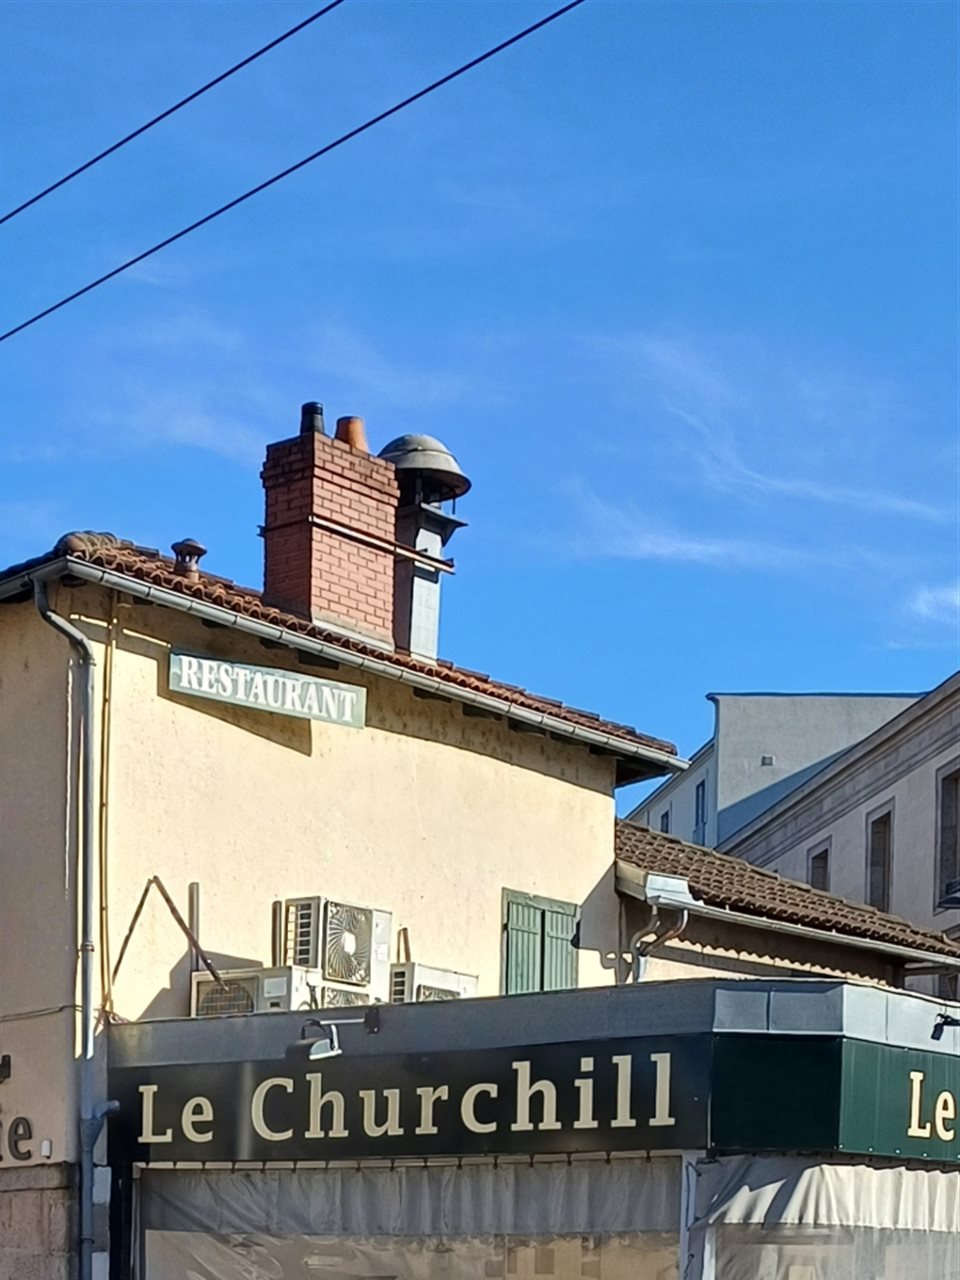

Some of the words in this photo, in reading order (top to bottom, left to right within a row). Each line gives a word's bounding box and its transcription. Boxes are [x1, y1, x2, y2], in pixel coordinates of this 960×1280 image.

[179, 654, 357, 722] RESTAURANT
[138, 1084, 214, 1144] Le
[251, 1052, 676, 1142] Churchill
[907, 1071, 955, 1141] Le
